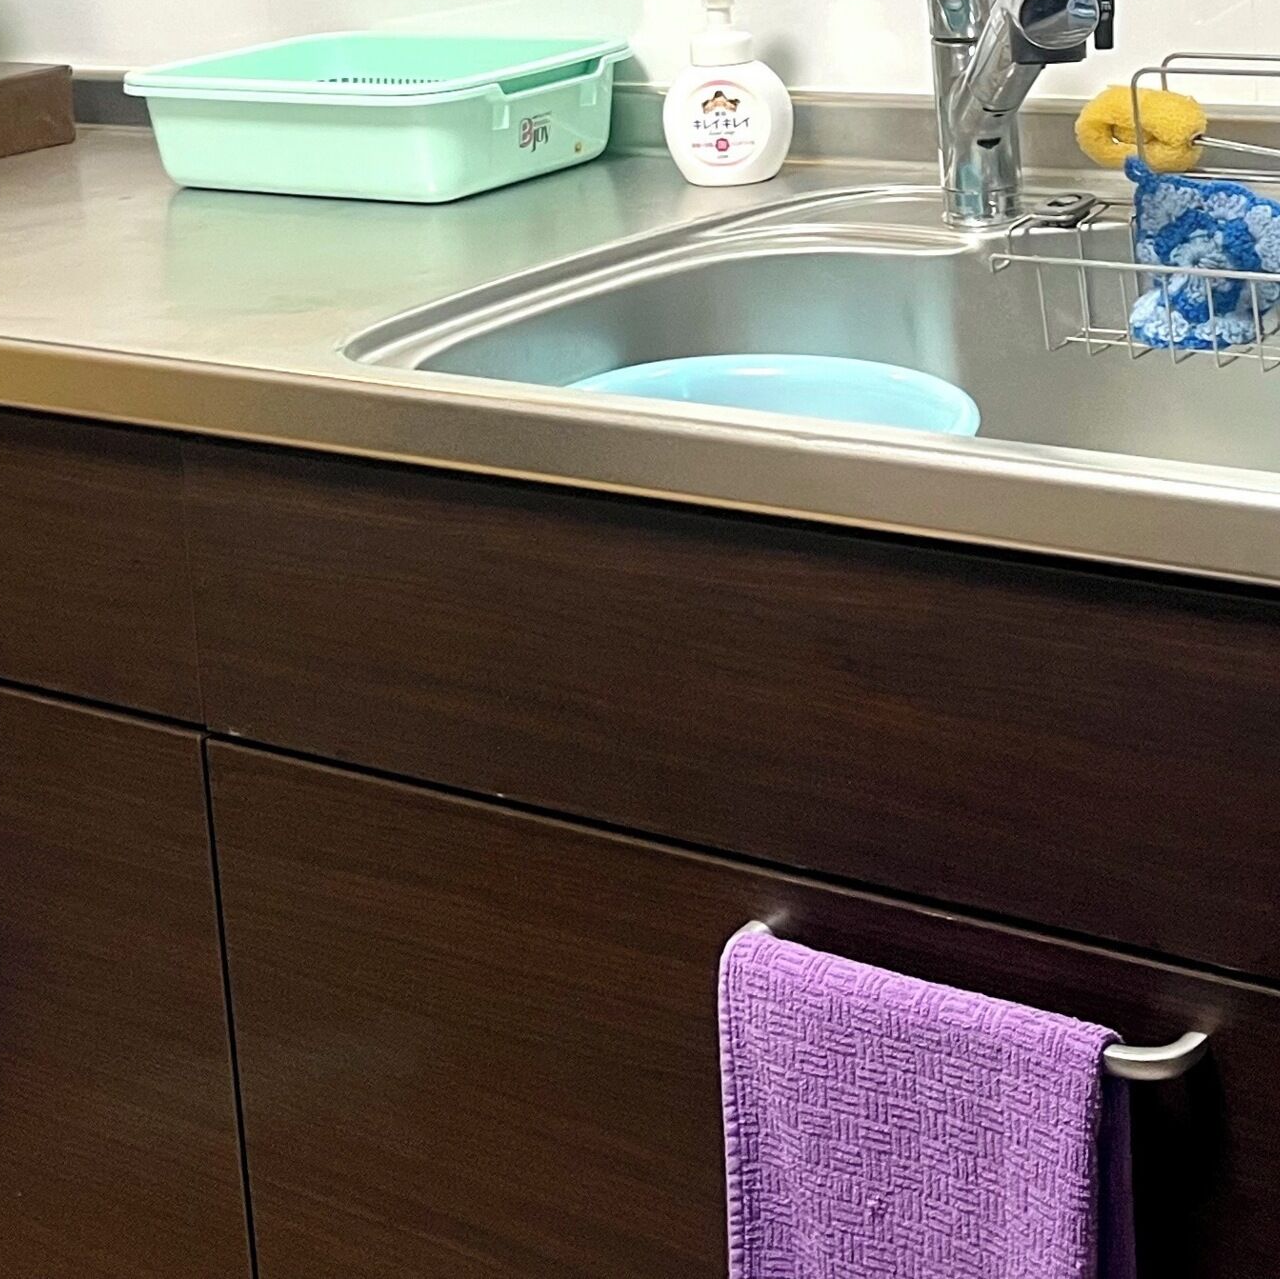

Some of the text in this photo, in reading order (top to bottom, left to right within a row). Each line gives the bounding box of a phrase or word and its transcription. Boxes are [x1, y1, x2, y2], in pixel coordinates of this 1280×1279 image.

[692, 117, 751, 130] キレイキレイ
